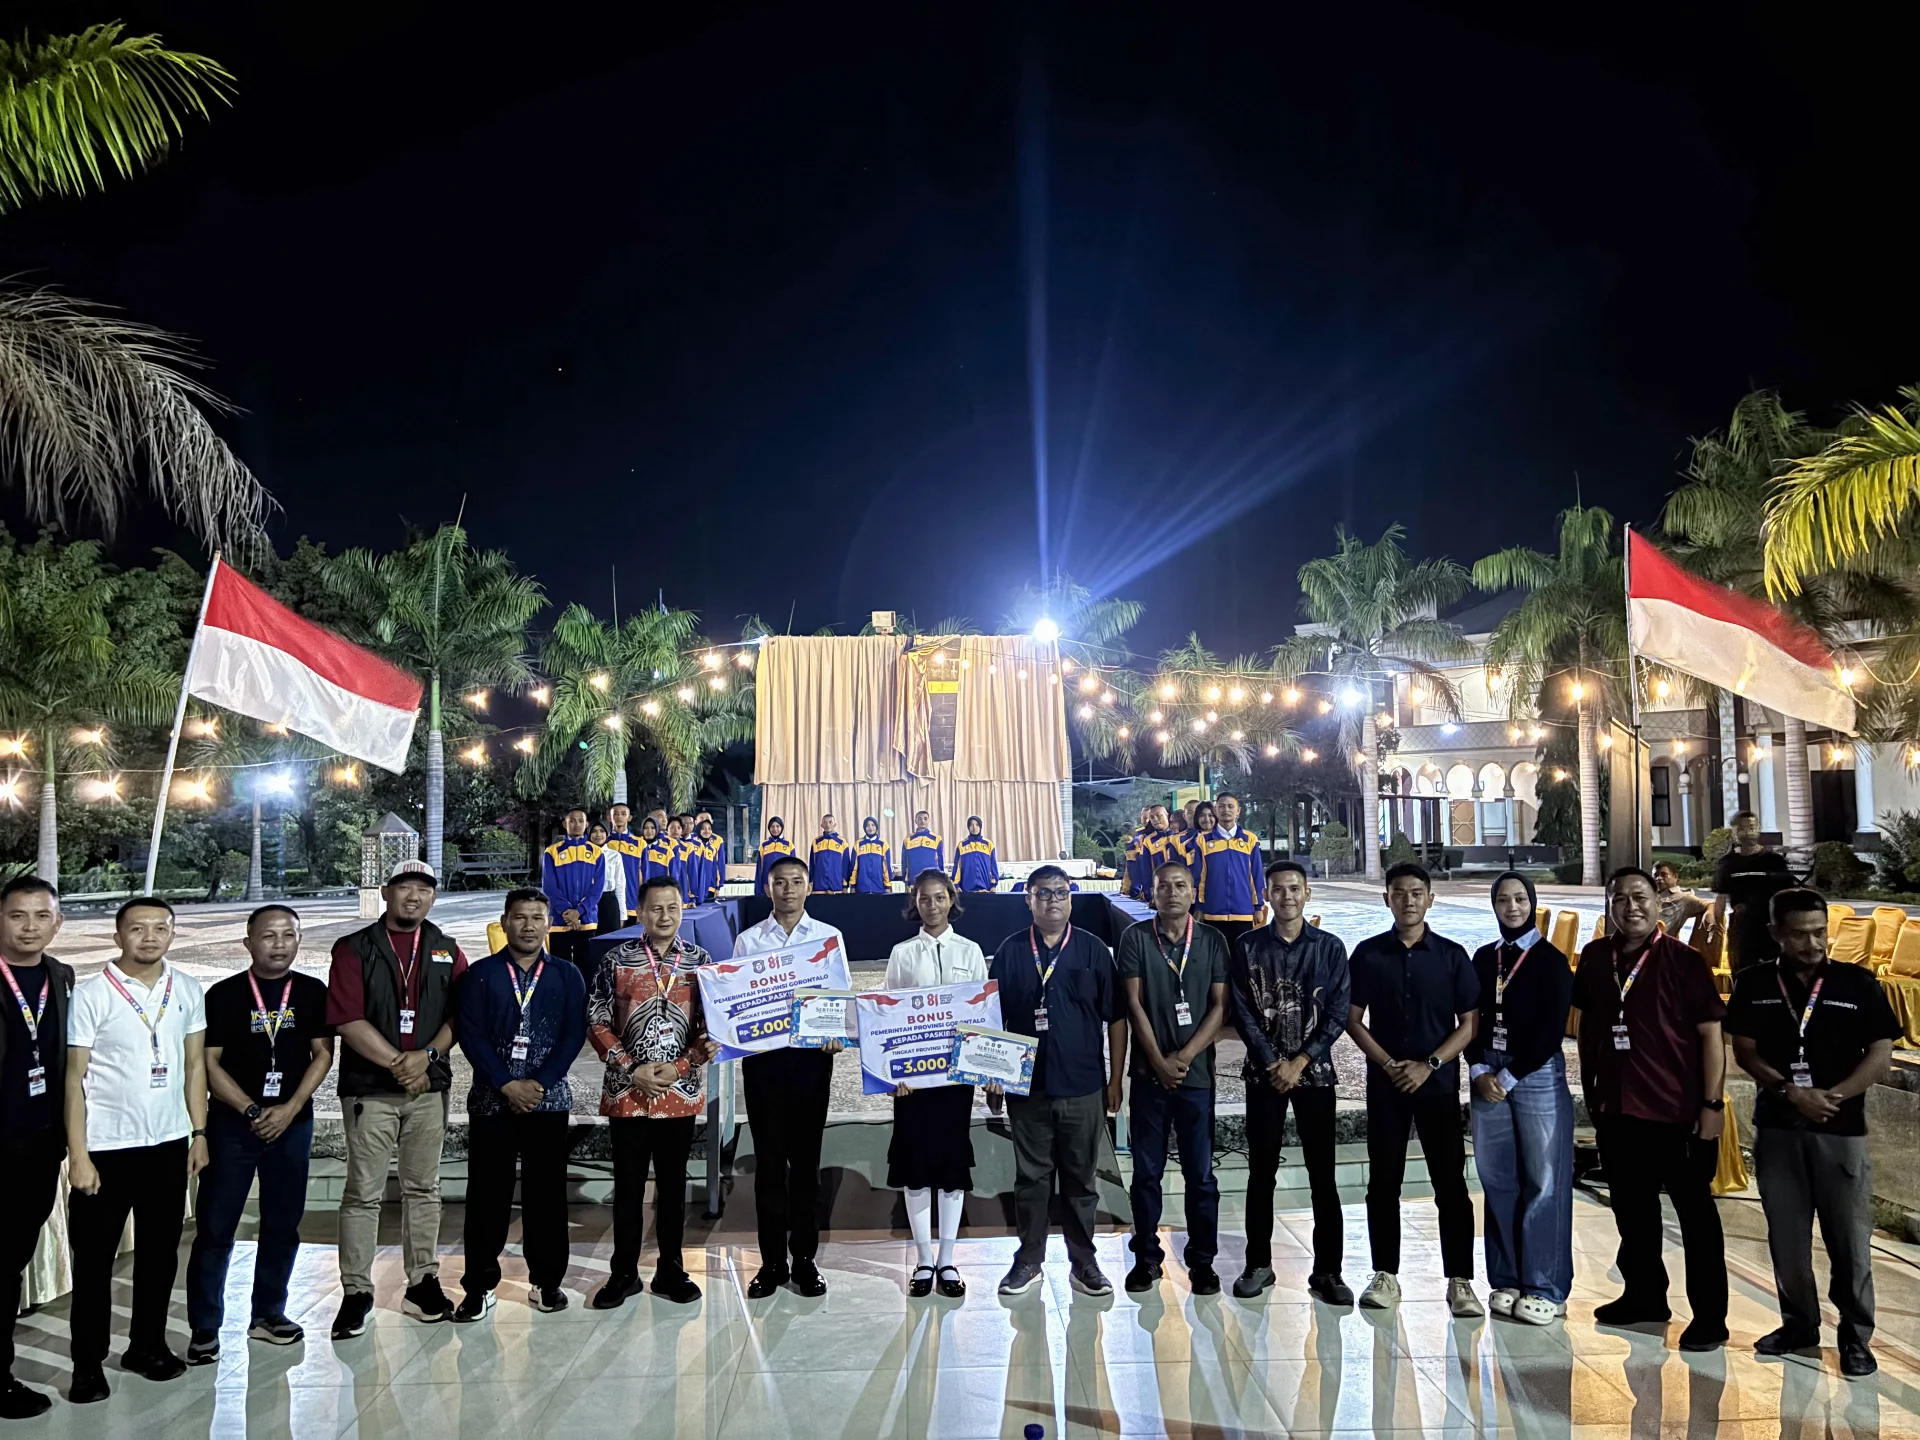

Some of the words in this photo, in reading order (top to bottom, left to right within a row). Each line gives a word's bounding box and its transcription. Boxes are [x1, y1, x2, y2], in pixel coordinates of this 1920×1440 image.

[750, 971, 796, 989] BONUS
[713, 991, 756, 1004] PEMERINTAH
[757, 983, 788, 995] PROVINSI
[789, 974, 829, 988] GORONTALO
[736, 997, 768, 1011] KEPADA
[1822, 1000, 1858, 1010] COMMUNITY
[737, 1012, 760, 1021] TINGKAT
[761, 1006, 786, 1016] PROVINSI
[907, 1011, 953, 1024] BONUS
[870, 1026, 913, 1036] PEMERINTAH
[913, 1022, 944, 1031] PROVINSI
[892, 1034, 924, 1045] KEPADA
[892, 1048, 915, 1056] TINGKAT
[916, 1045, 941, 1053] PROVINSI
[977, 1044, 1009, 1056] SERTIFIKAT
